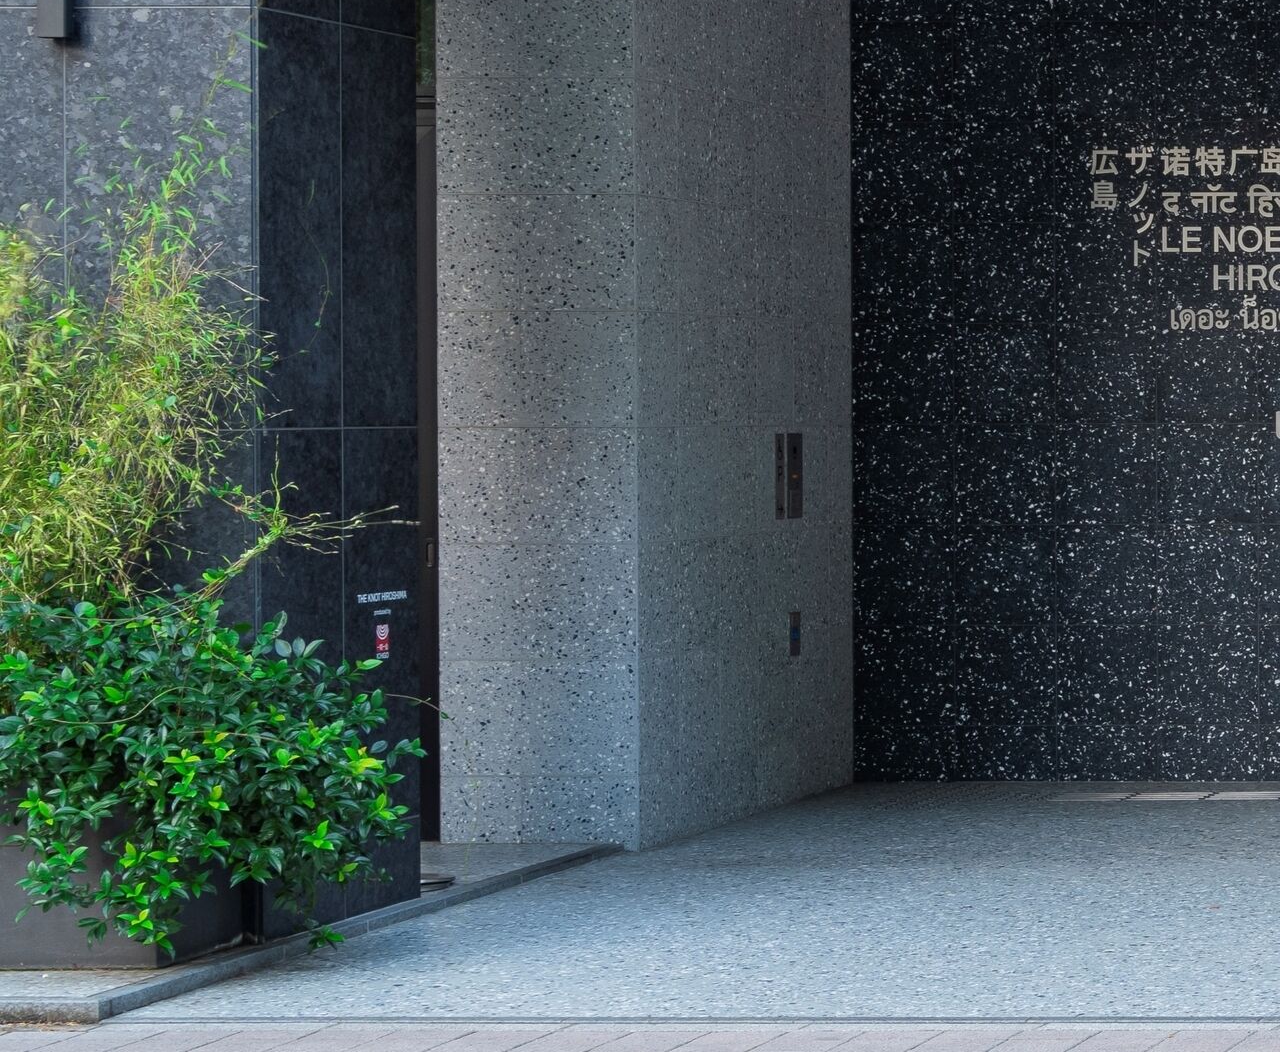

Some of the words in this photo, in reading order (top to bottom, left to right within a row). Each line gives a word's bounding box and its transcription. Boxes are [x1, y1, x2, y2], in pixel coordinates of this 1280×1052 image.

[1090, 147, 1119, 209] 広島
[1162, 191, 1181, 216] द
[1190, 183, 1238, 214] नॉट
[1162, 226, 1202, 253] LE
[1170, 307, 1230, 330] เดอะ
[357, 594, 368, 604] THE
